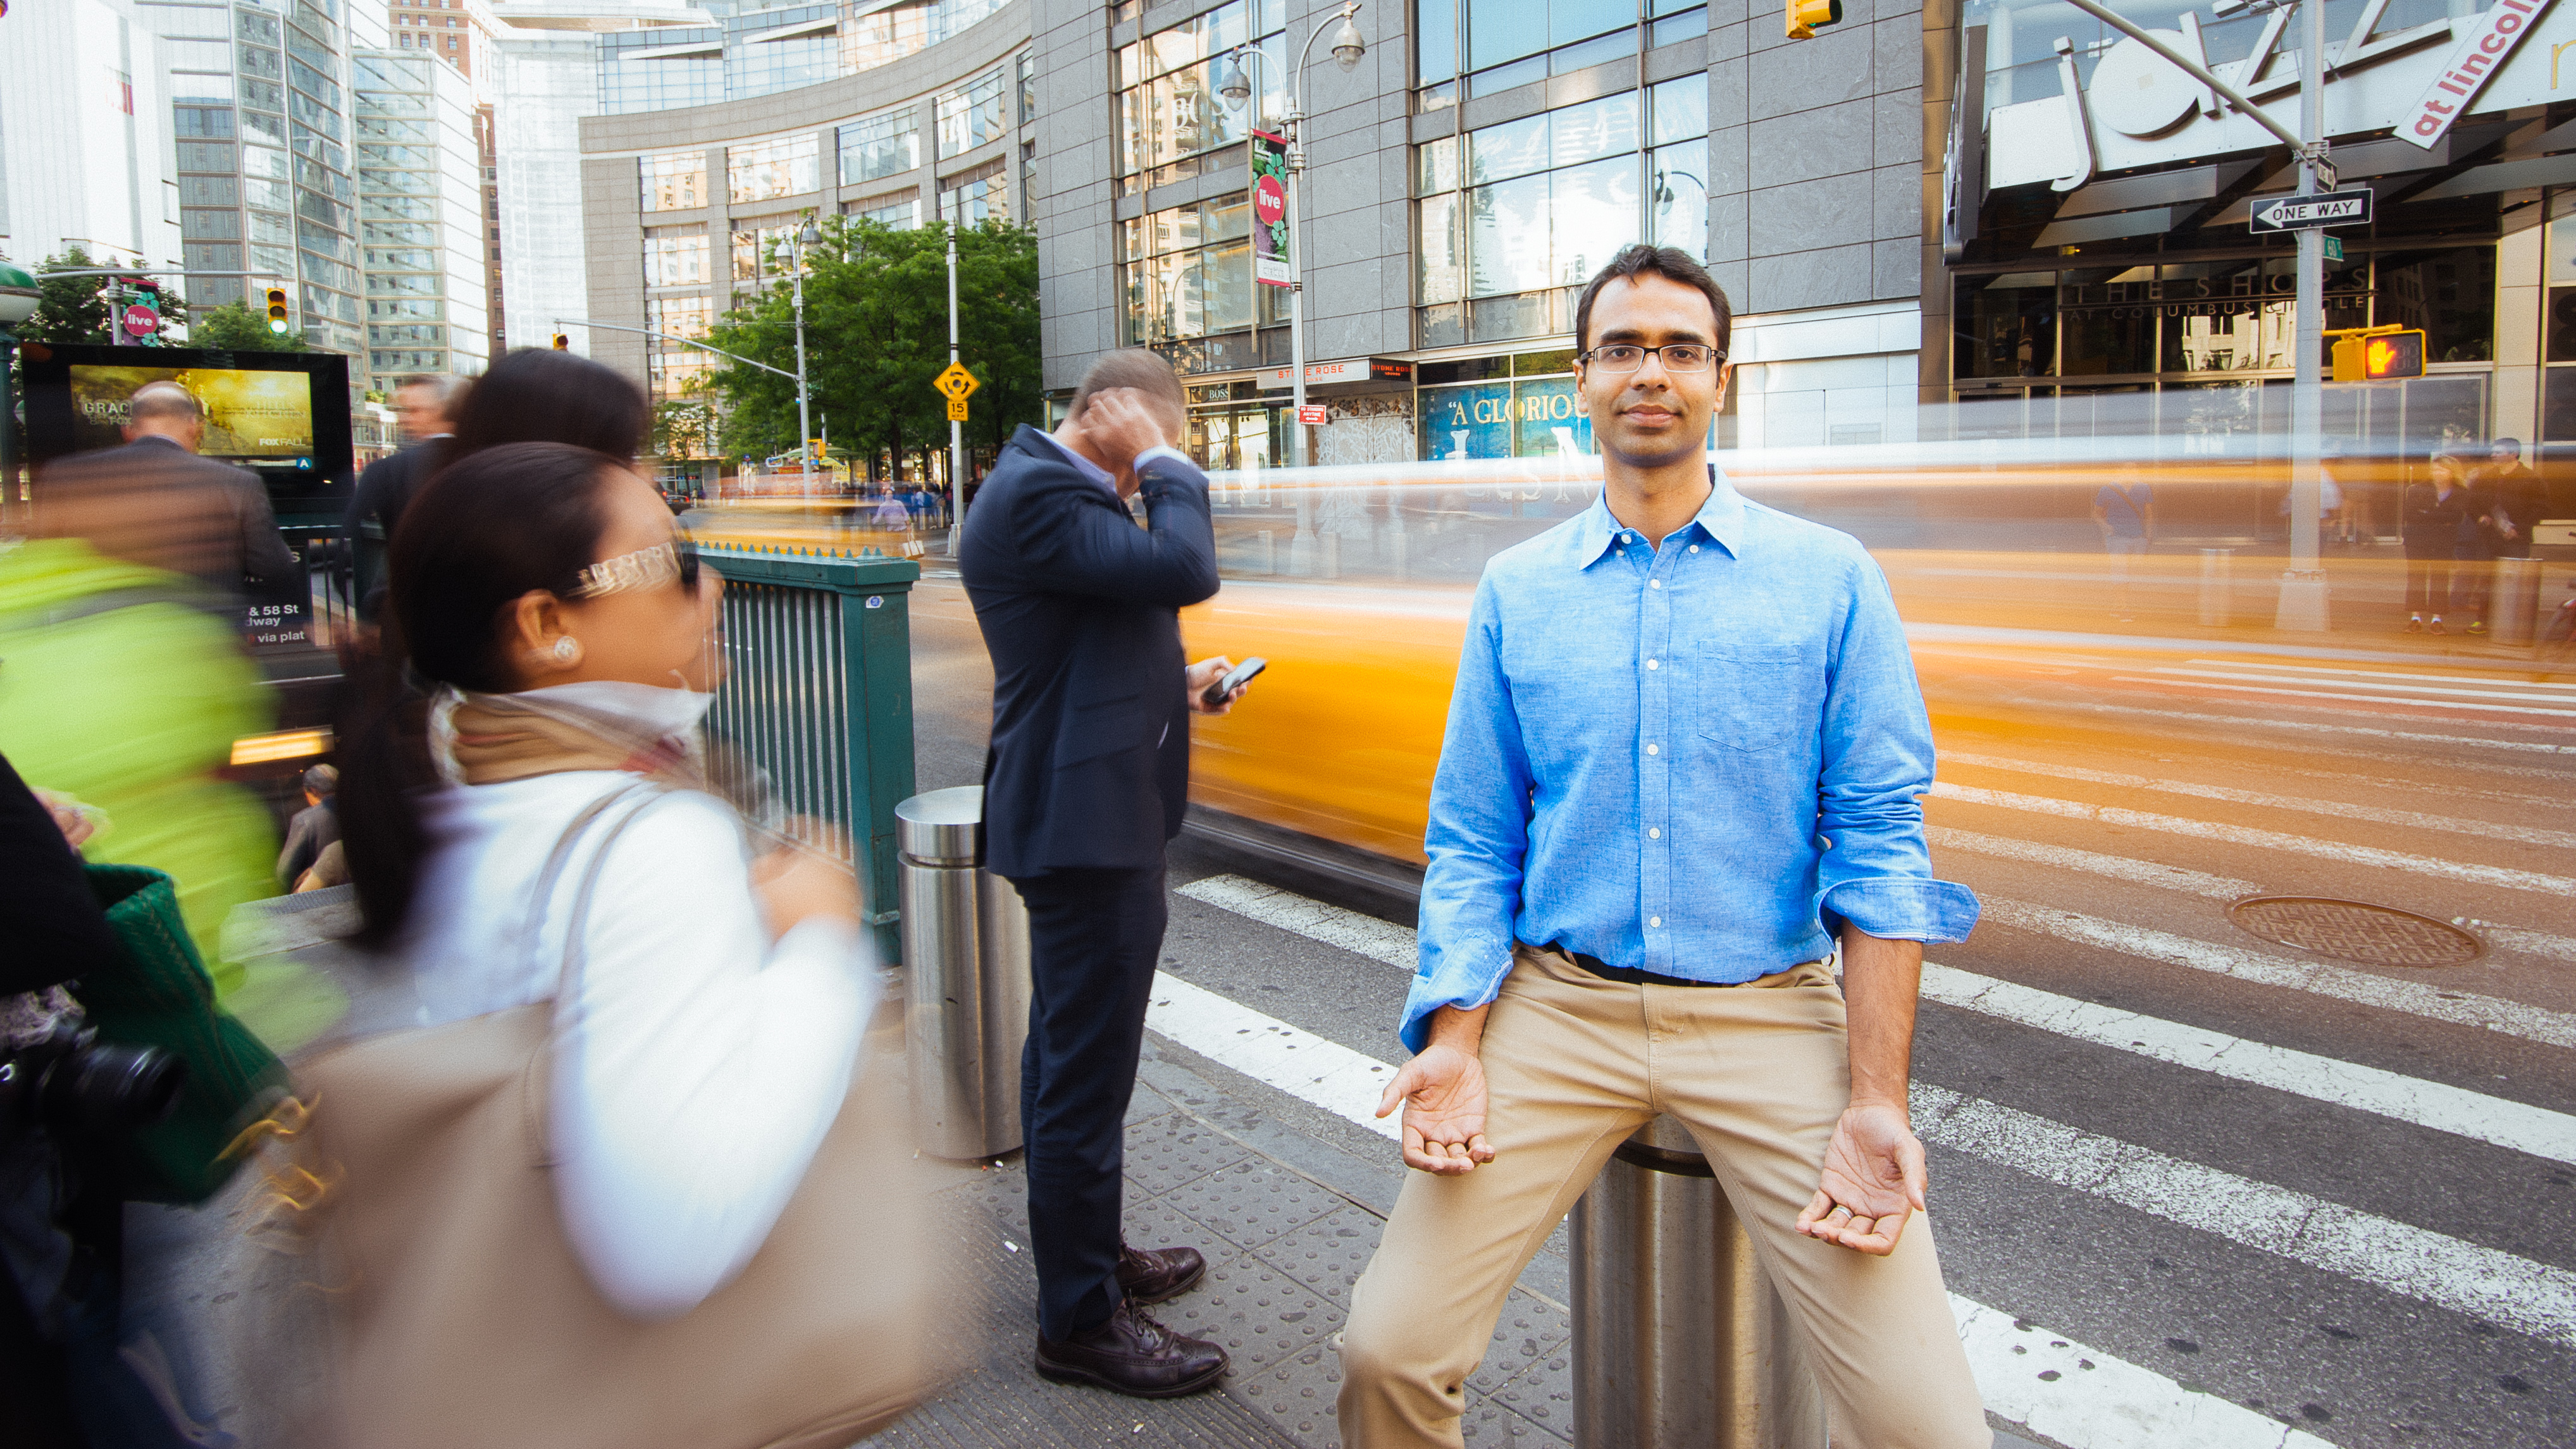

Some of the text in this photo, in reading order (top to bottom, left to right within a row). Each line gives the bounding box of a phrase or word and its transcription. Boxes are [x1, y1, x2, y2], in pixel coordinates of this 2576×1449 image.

[2414, 0, 2541, 137] at lincol
[2051, 0, 2452, 192] jazz
[1259, 188, 1281, 209] live
[2273, 201, 2353, 221] ONE WAY
[2073, 279, 2163, 304] THE
[2266, 297, 2365, 313] CICLE
[128, 314, 153, 326] live
[1278, 365, 1345, 379] STE ROSE
[1209, 388, 1229, 399] BOSS
[952, 403, 964, 412] 15
[249, 605, 299, 616] & 58 St
[257, 631, 305, 643] via plat
